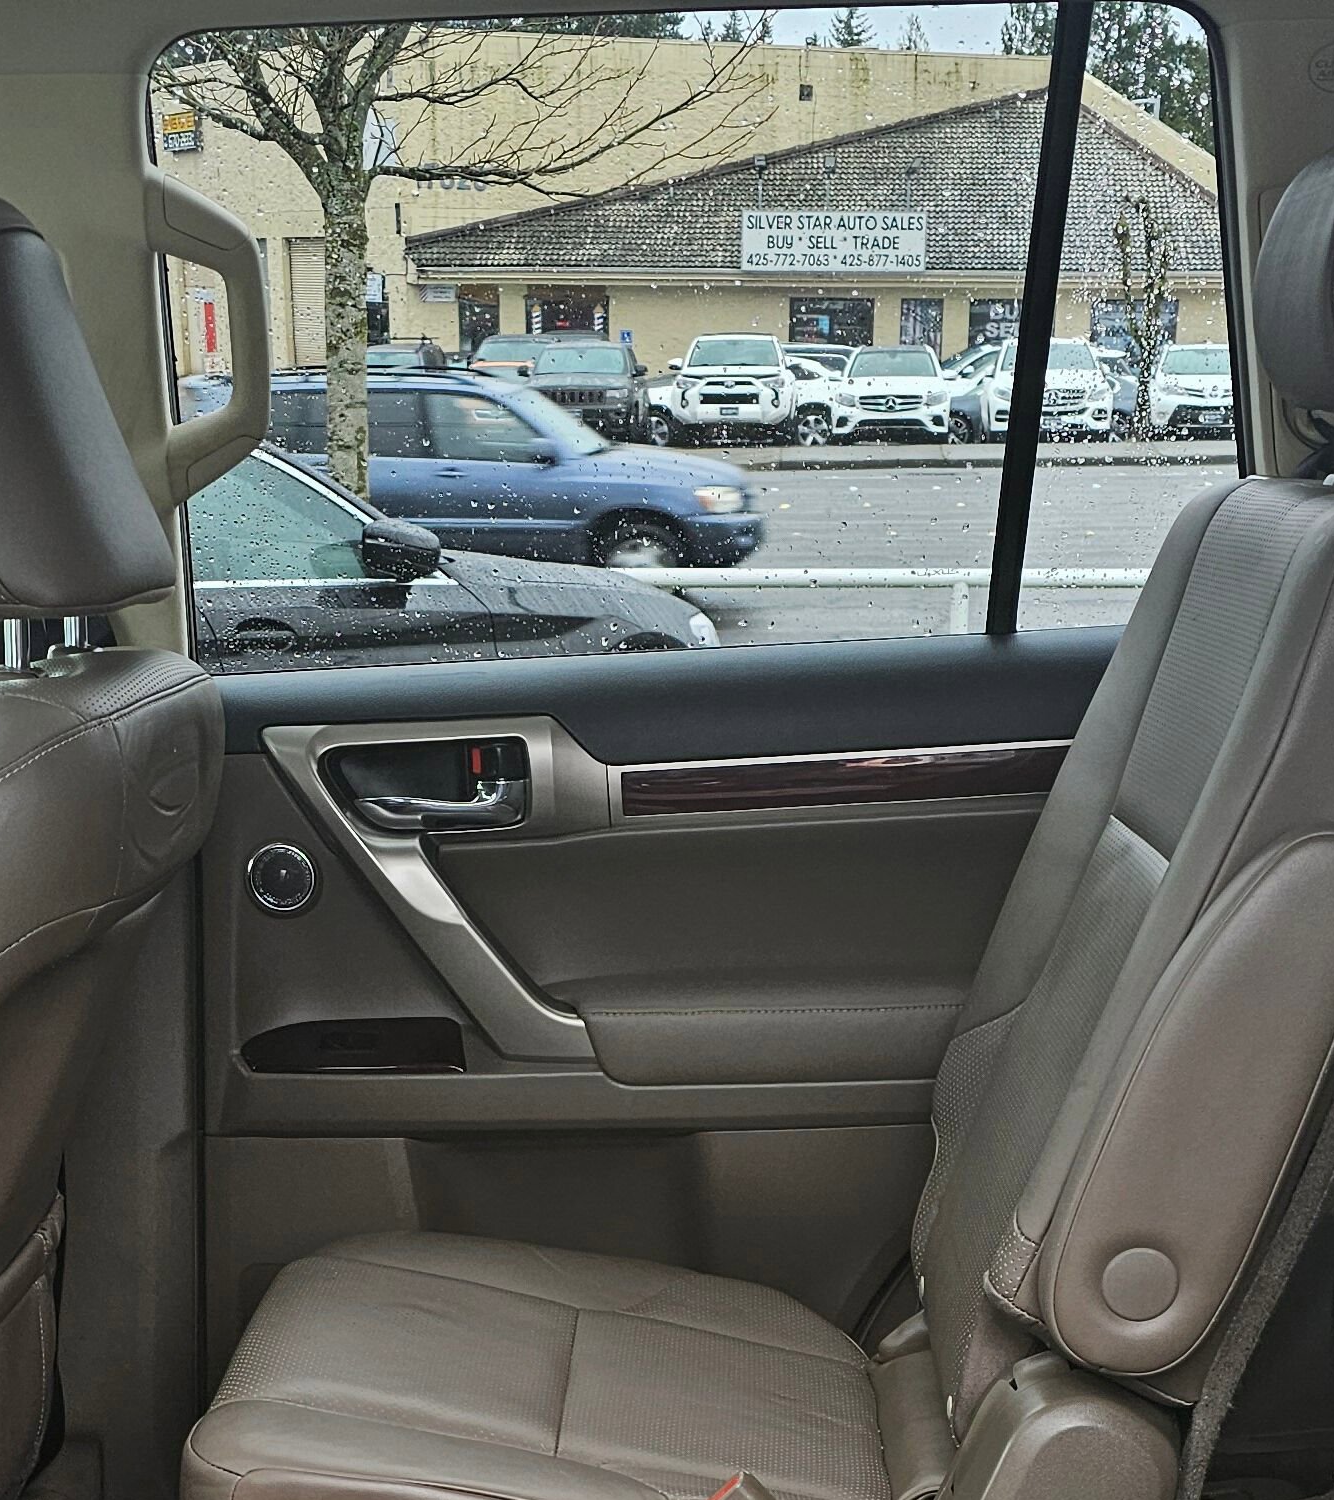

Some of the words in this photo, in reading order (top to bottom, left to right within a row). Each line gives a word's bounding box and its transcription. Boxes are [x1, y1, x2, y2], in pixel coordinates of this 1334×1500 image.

[746, 215, 793, 231] SILVER
[797, 215, 832, 231] STAR
[837, 216, 877, 231] AUTO
[881, 216, 924, 231] SALES
[767, 236, 793, 249] BUY
[808, 236, 837, 250] SELL
[853, 236, 900, 250] TRADE
[746, 253, 831, 267] 425-772-7063
[840, 253, 922, 268] 425-877-1405
[990, 304, 1022, 320] BU
